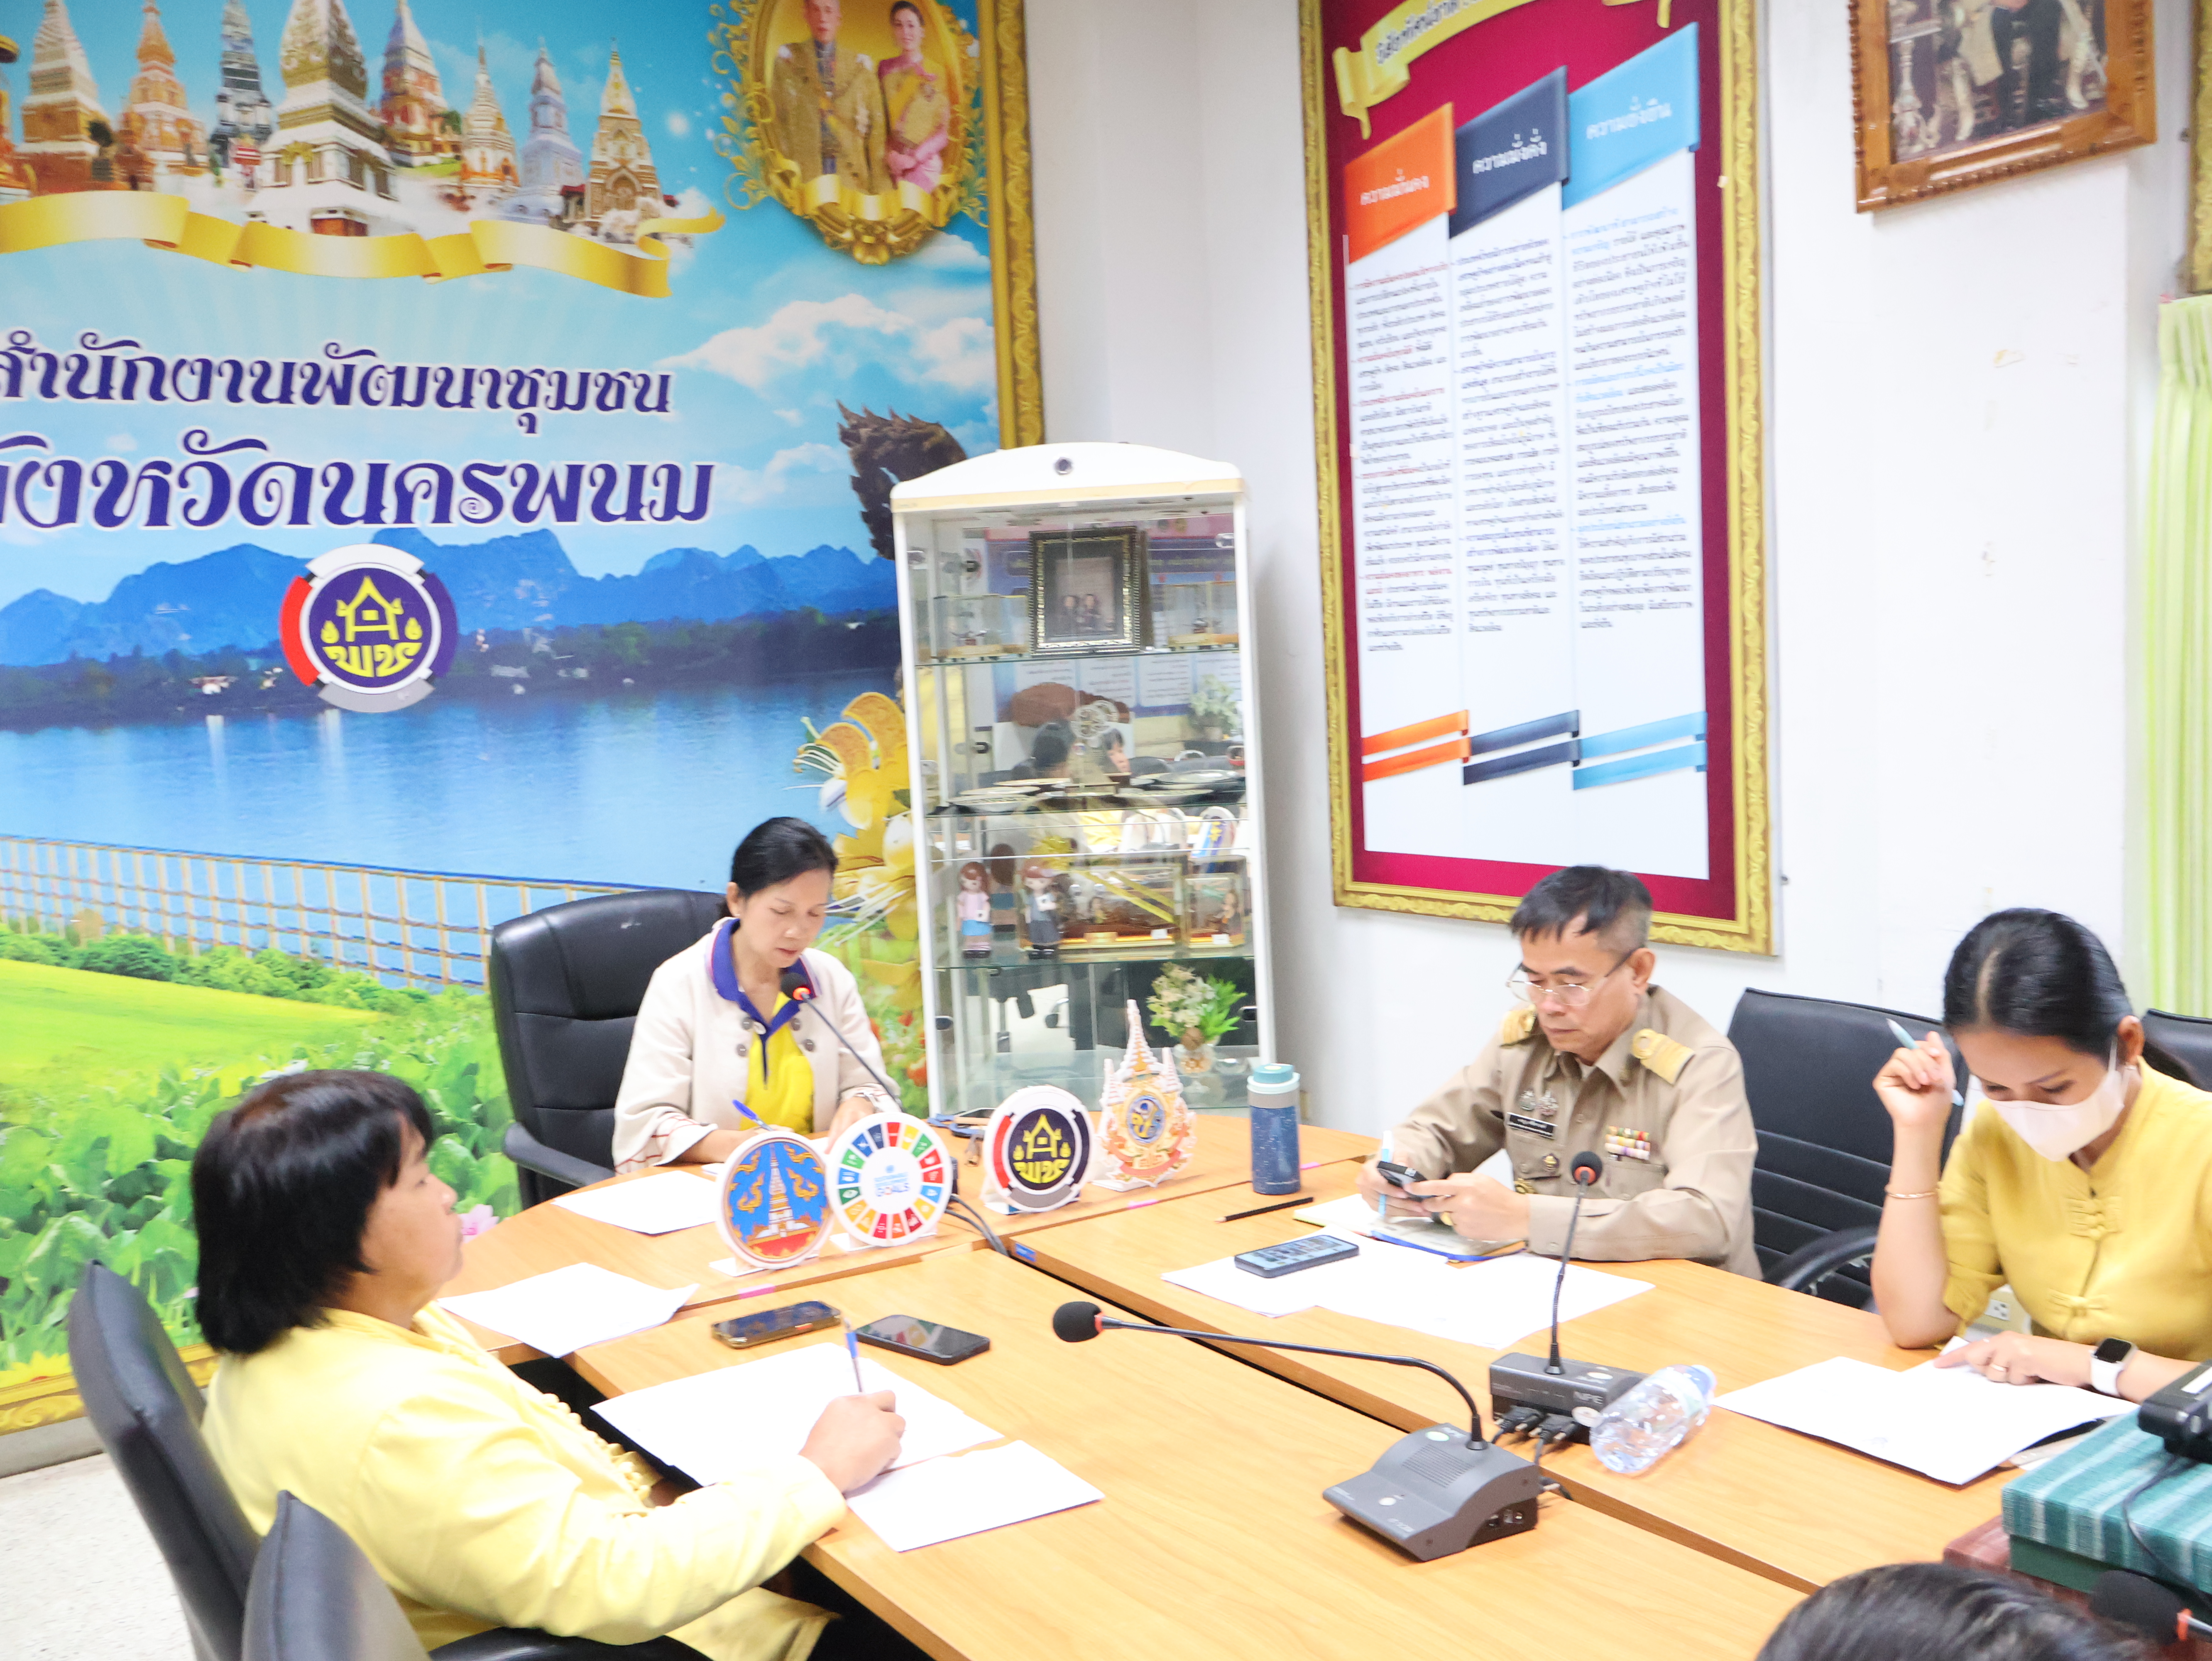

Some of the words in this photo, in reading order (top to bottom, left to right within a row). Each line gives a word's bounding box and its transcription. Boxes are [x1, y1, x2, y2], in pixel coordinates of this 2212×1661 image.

[0, 429, 715, 528] ังหวัดนครพนม
